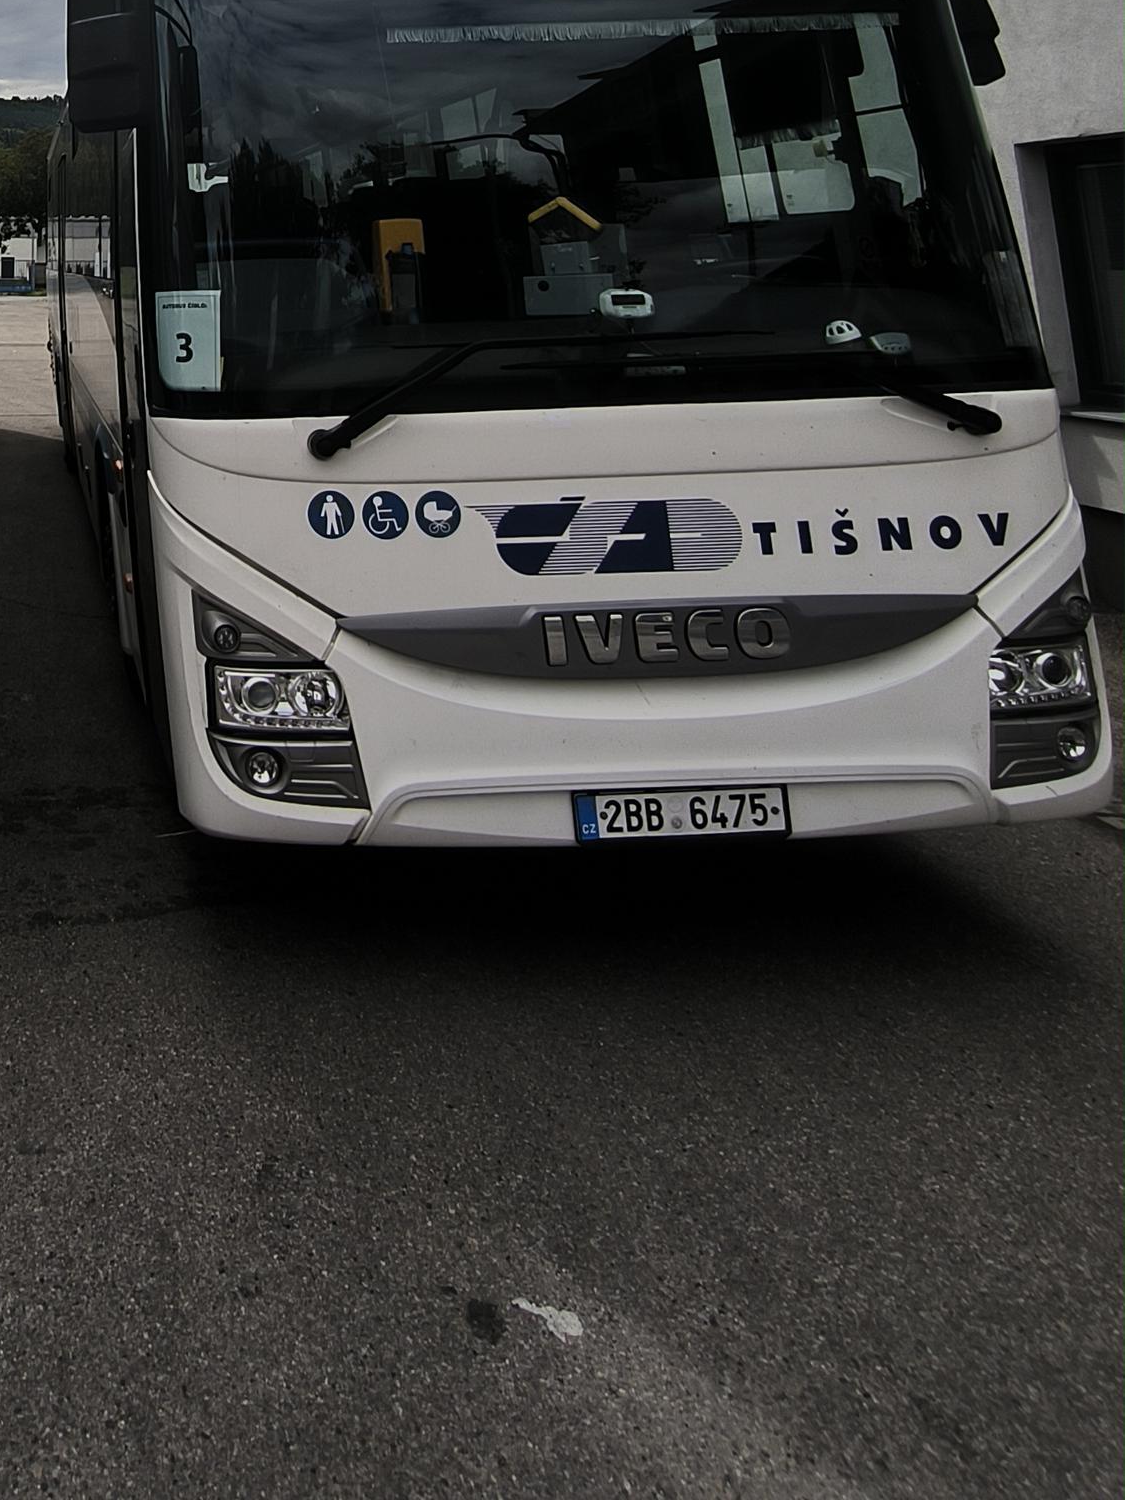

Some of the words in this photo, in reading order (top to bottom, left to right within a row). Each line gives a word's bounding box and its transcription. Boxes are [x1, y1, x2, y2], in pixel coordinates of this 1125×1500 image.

[175, 332, 194, 363] 3
[751, 508, 1009, 556] TIŠNOV
[541, 607, 792, 667] IVECO
[581, 824, 597, 834] CZ
[604, 798, 664, 833] 2BB
[689, 793, 769, 830] 6475
